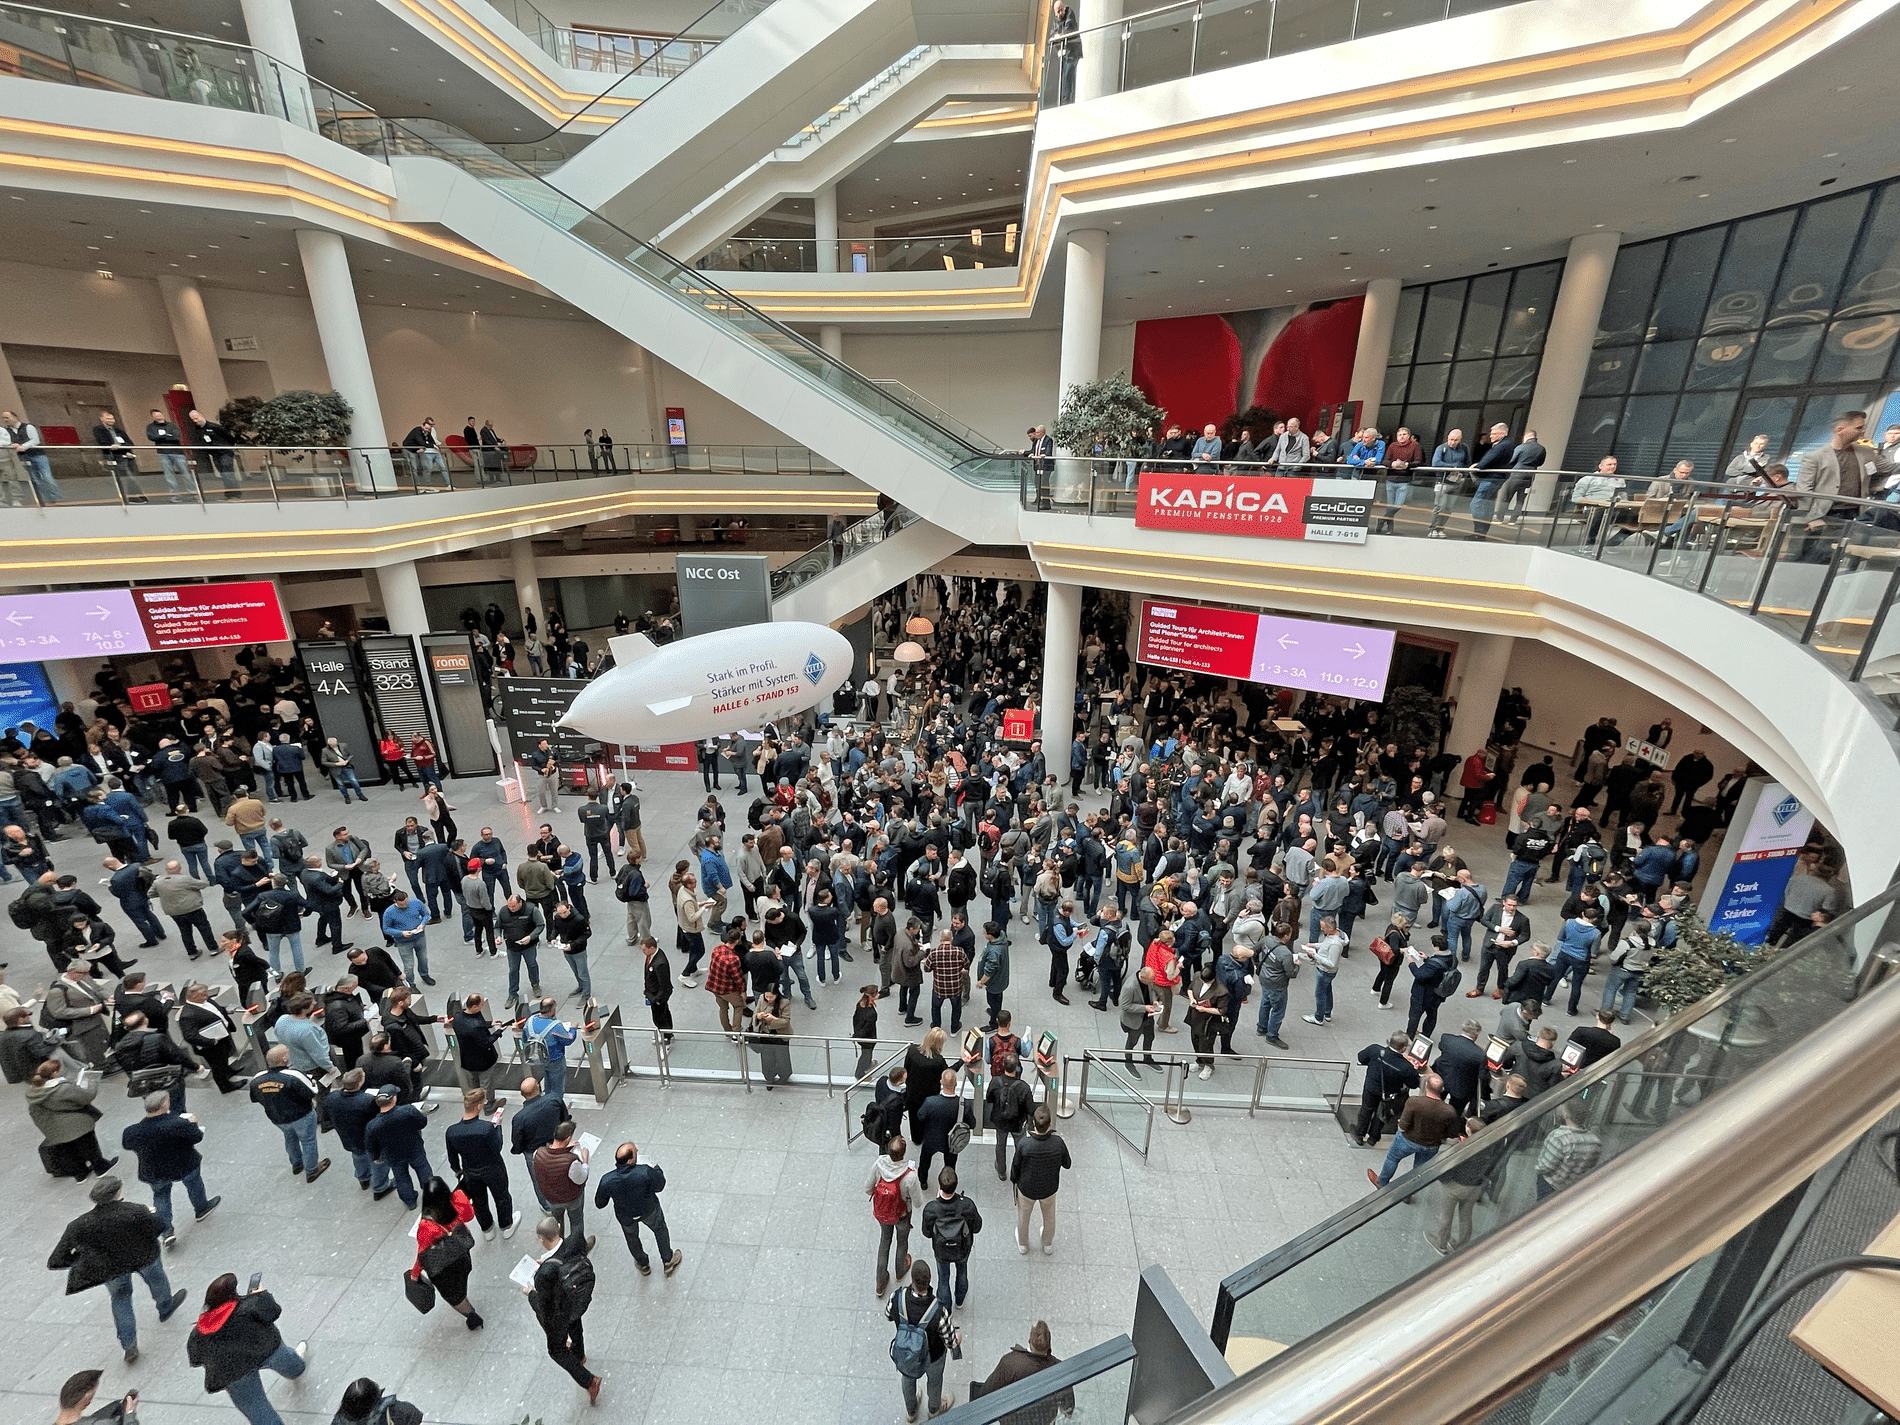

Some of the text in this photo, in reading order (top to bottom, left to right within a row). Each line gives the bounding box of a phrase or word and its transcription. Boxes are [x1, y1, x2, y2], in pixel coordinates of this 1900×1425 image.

[1310, 501, 1366, 514] SCHÜCO
[1154, 508, 1283, 523] PREMIUM FENSTER 1928
[1310, 529, 1333, 537] HALLE
[686, 567, 741, 580] NCC Ost
[148, 606, 176, 614] Guided
[153, 621, 181, 629] Guided
[212, 617, 248, 625] architects
[1150, 621, 1171, 630] Guided
[1172, 624, 1187, 632] Tours
[172, 626, 205, 635] planners
[38, 635, 60, 645] 3A
[94, 640, 125, 650] 10.0
[1148, 636, 1170, 645] Guided
[1193, 643, 1223, 653] architects
[1159, 644, 1185, 653] planners
[436, 658, 466, 667] roma
[1146, 653, 1160, 661] Halle
[310, 661, 345, 673] Halle
[371, 658, 410, 670] Stand
[706, 660, 778, 684] Stark im Profil.
[1273, 665, 1281, 674] 3
[1290, 667, 1308, 678] 3A
[317, 678, 350, 695] 4A
[376, 673, 414, 691] 323
[711, 673, 799, 700] Stärker mit System.
[1320, 672, 1343, 684] 11.0
[1352, 677, 1378, 689] 12.0
[713, 700, 742, 714] HALLE
[743, 698, 749, 706] 6
[756, 689, 784, 703] STAND
[786, 685, 799, 695] 153
[1733, 882, 1759, 893] Stark
[1722, 907, 1757, 919] Stärker
